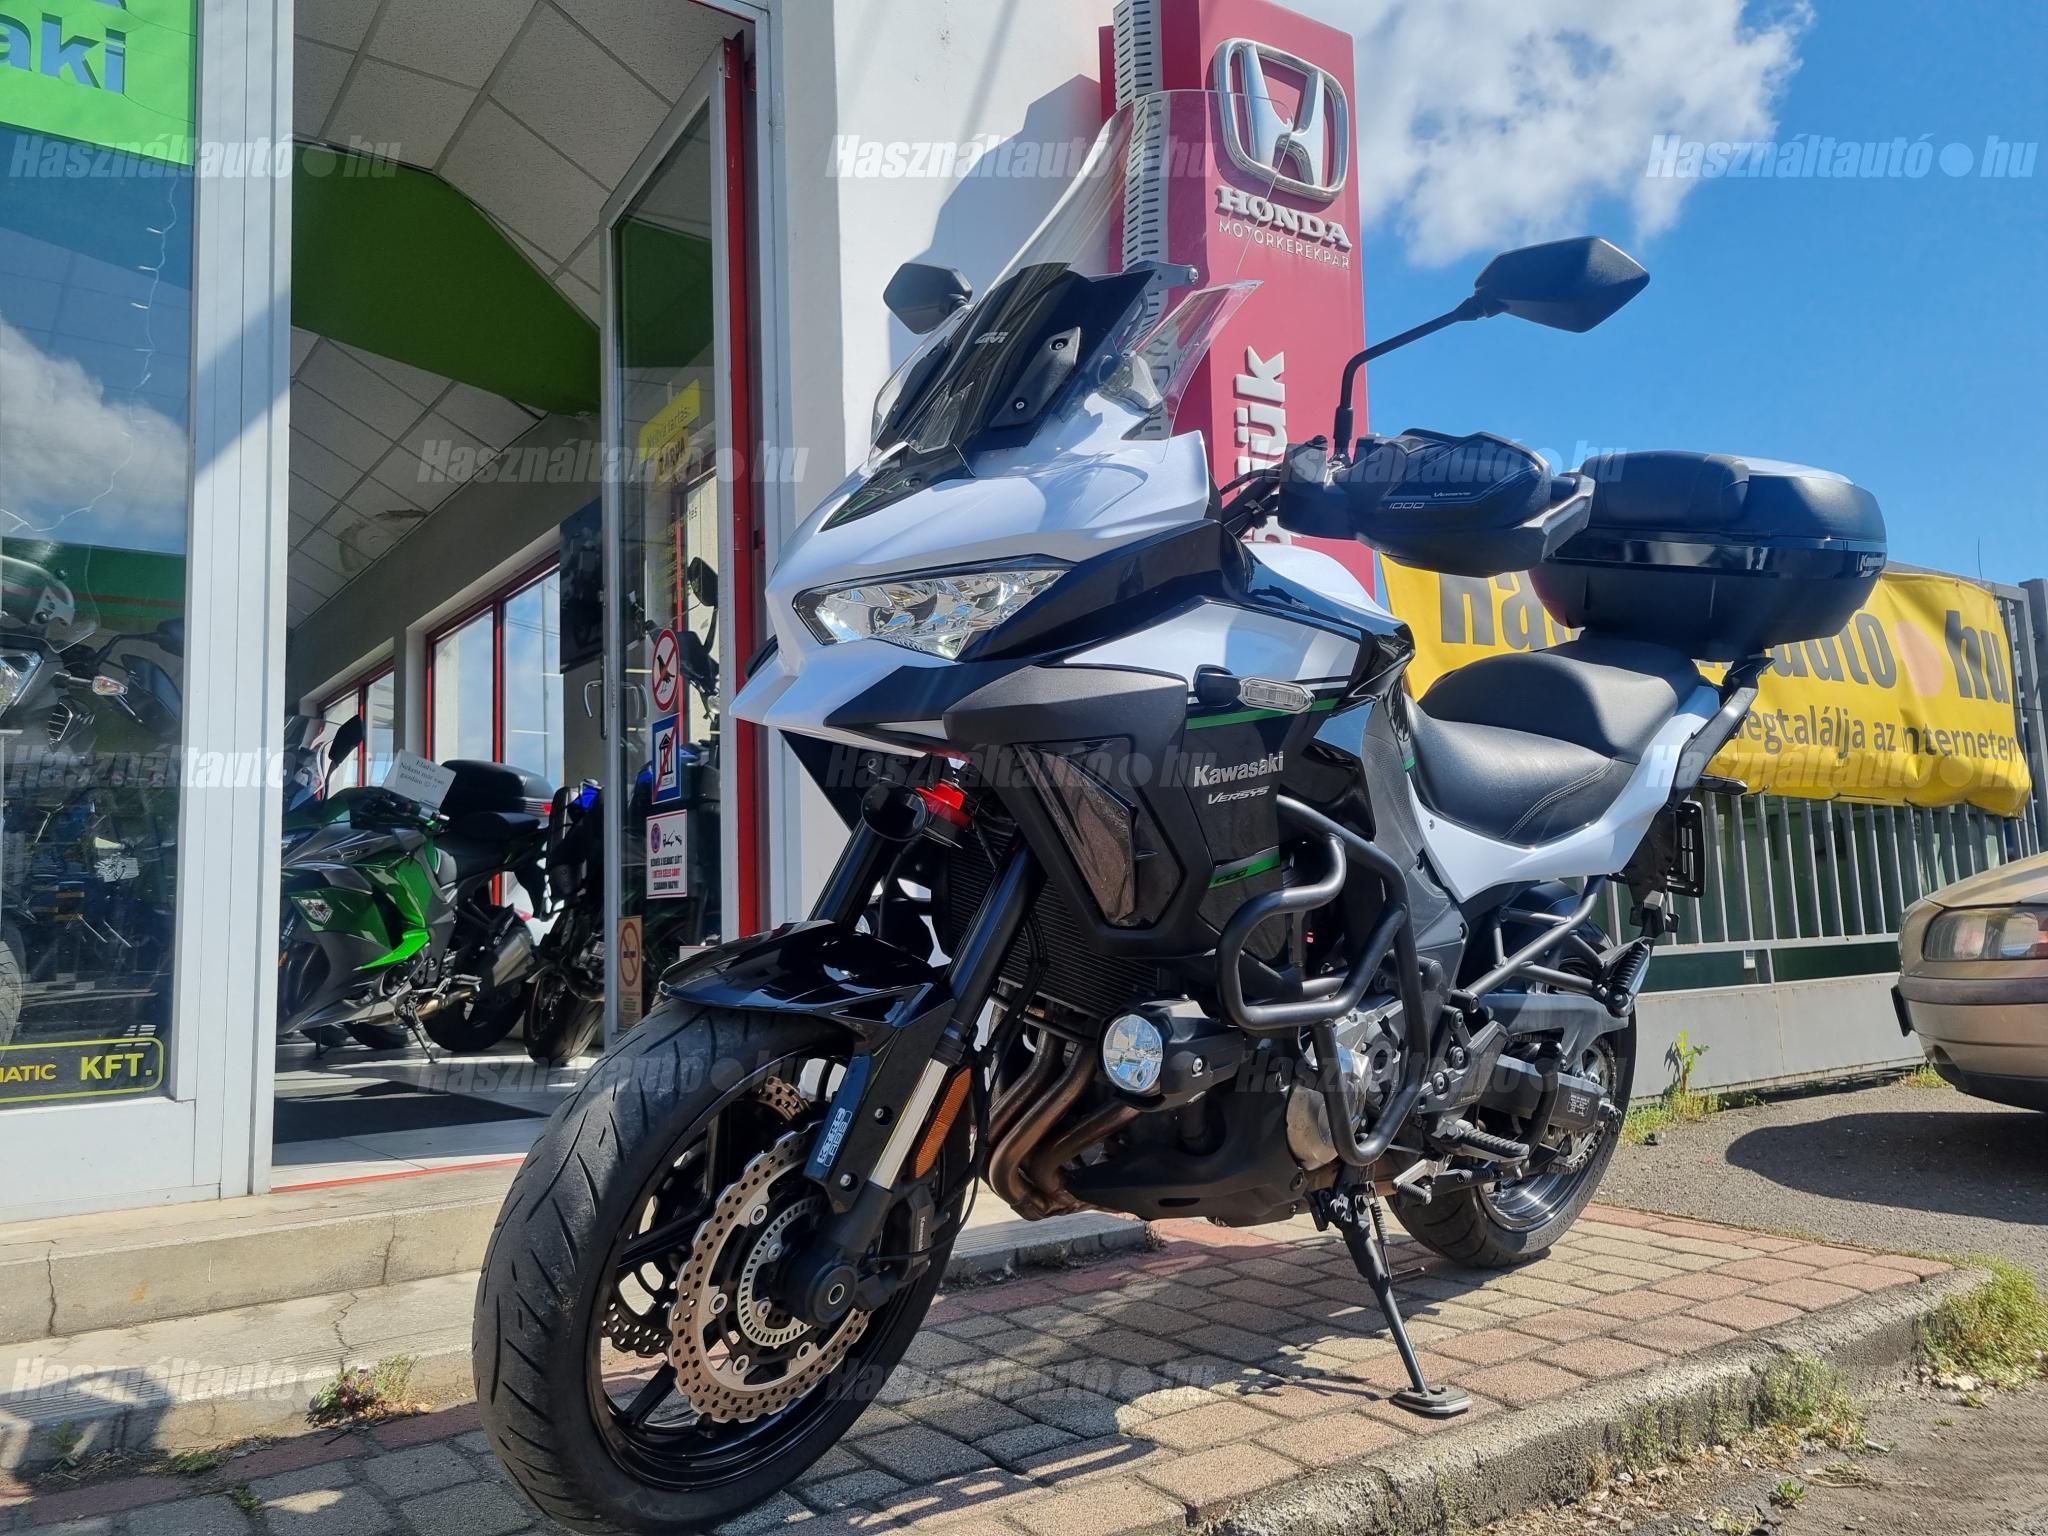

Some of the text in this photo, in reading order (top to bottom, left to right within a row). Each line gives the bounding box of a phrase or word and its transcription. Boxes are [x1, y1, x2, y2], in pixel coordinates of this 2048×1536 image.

[1216, 186, 1352, 249] HONDA
[1874, 719, 1897, 751] az
[1194, 751, 1284, 787] Kawasaki
[80, 1053, 152, 1081] KFT.
